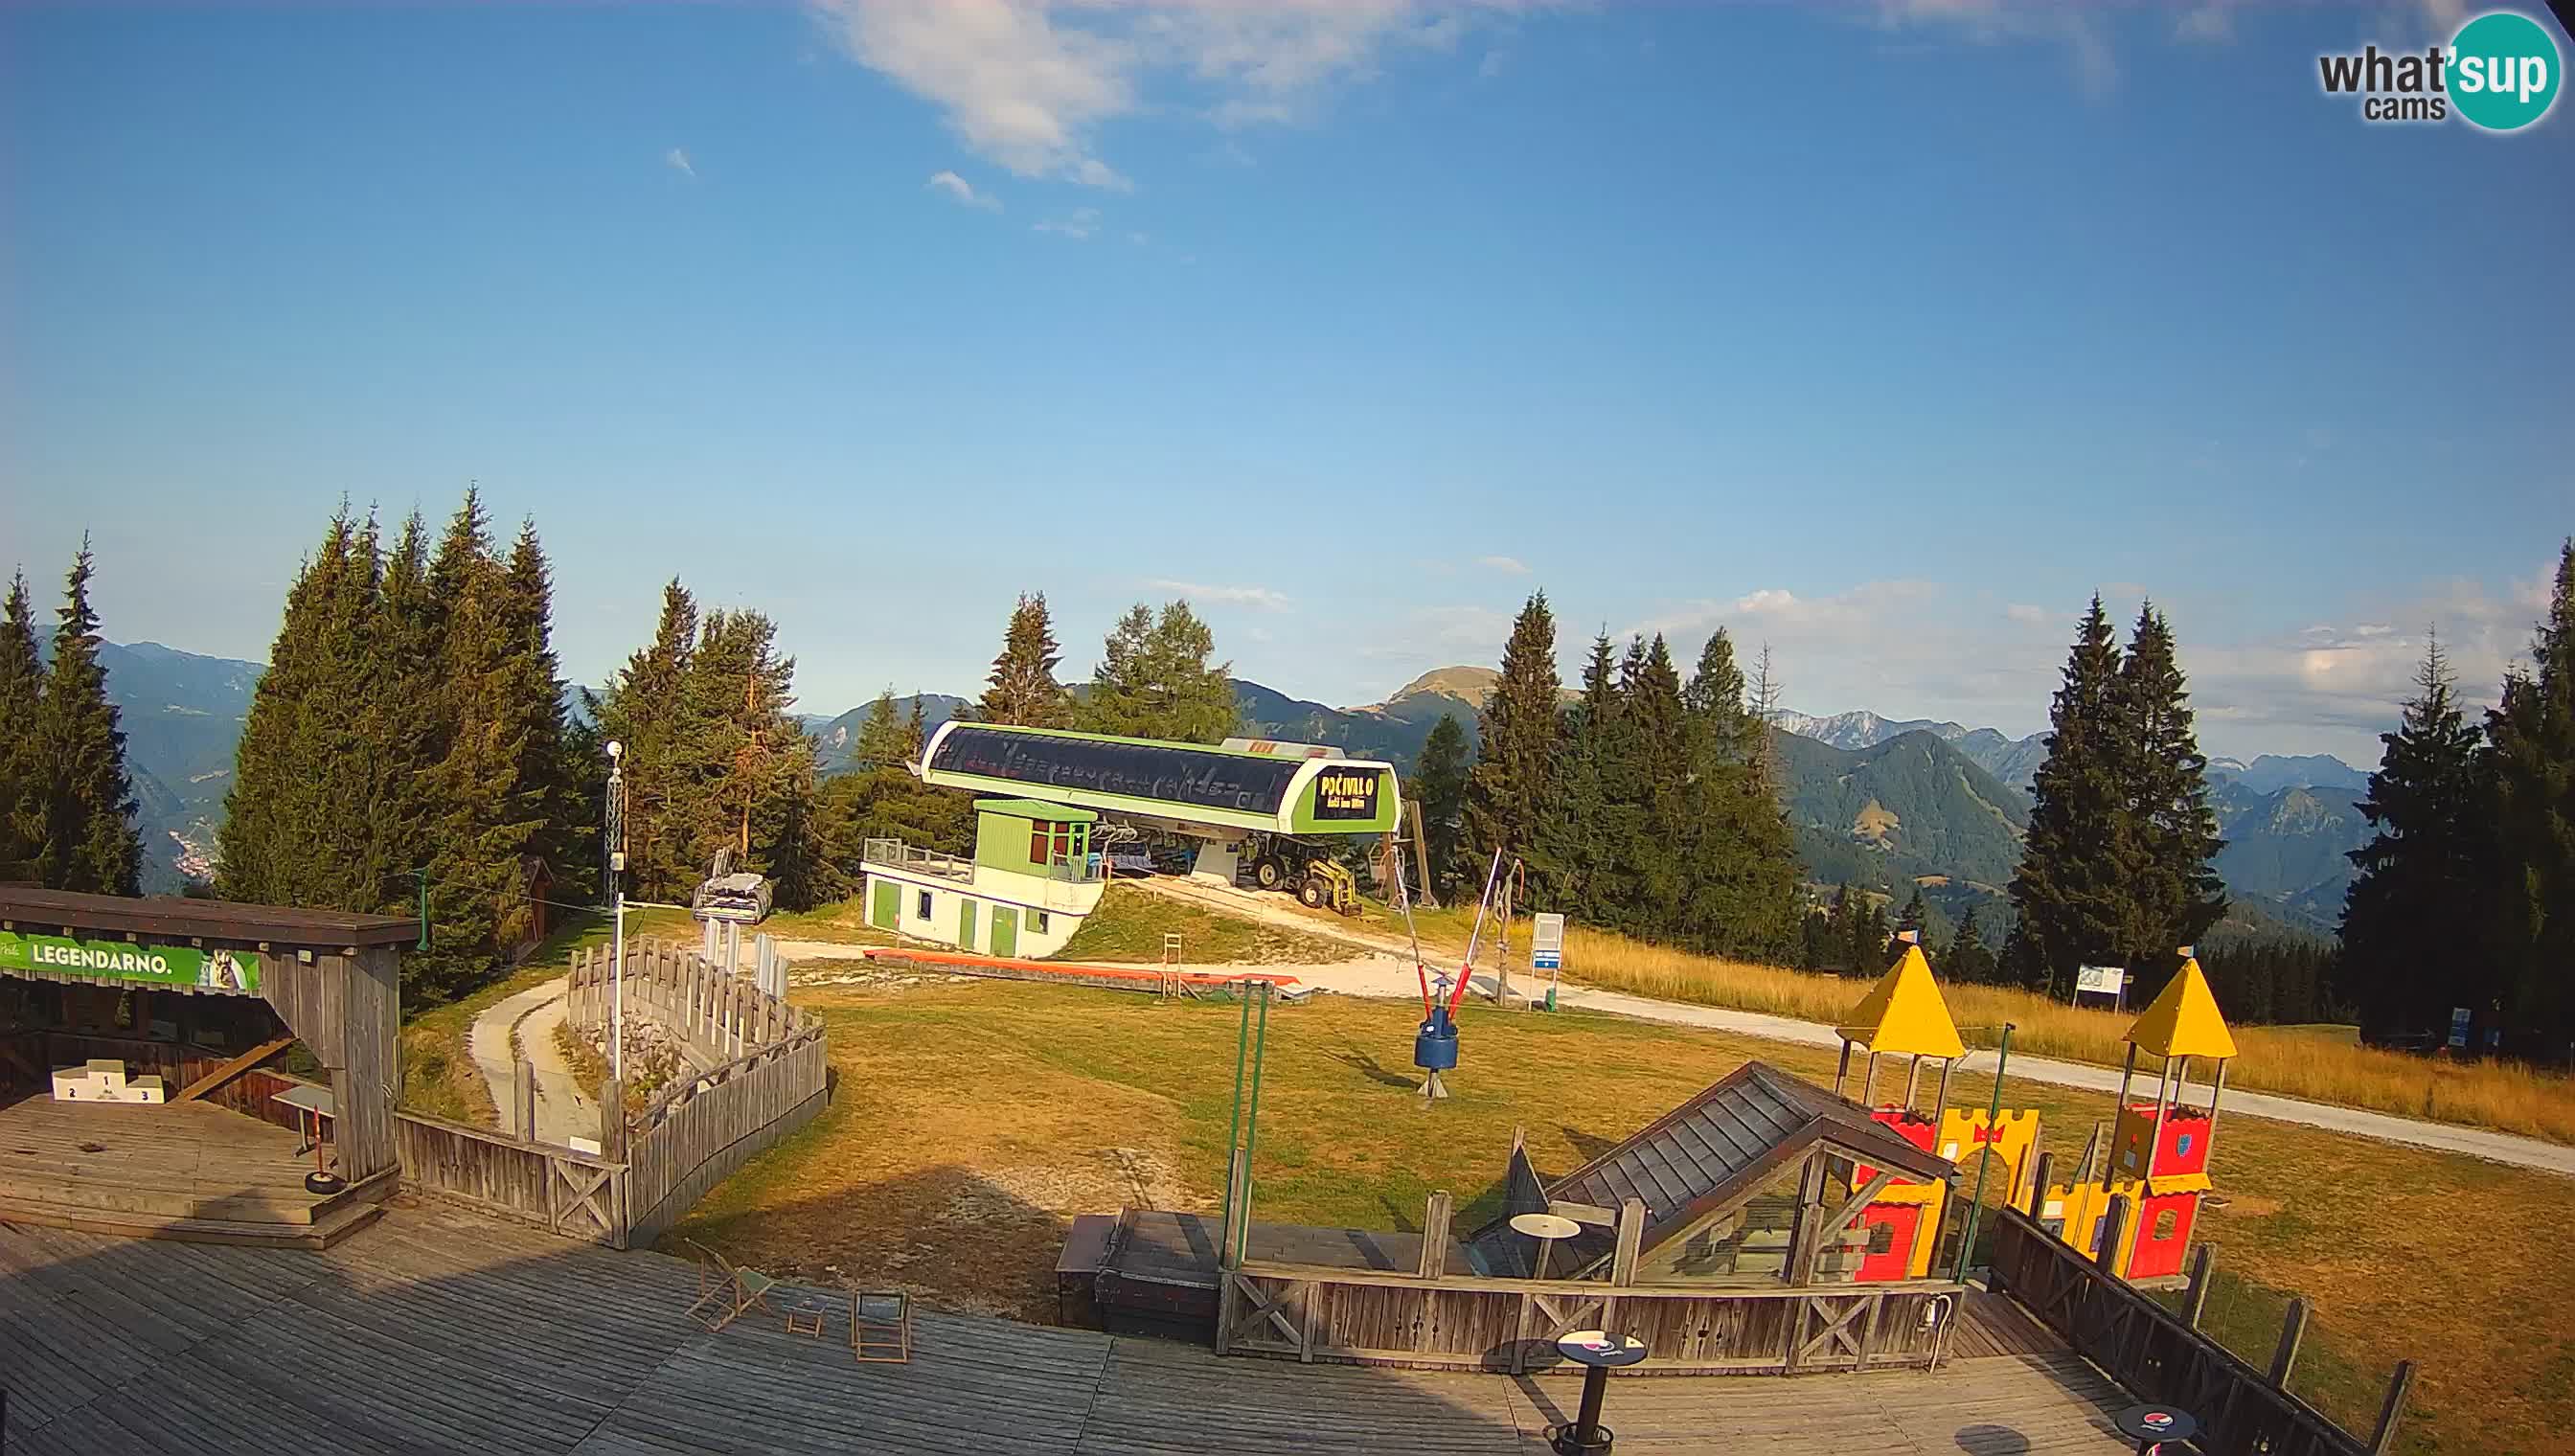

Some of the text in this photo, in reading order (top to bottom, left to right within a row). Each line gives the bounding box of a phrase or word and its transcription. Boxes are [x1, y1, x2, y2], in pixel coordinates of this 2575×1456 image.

[33, 944, 172, 975] LEGENDARNO.
[103, 1075, 109, 1086] 1
[69, 1087, 76, 1098] 2
[142, 1091, 148, 1101] 3
